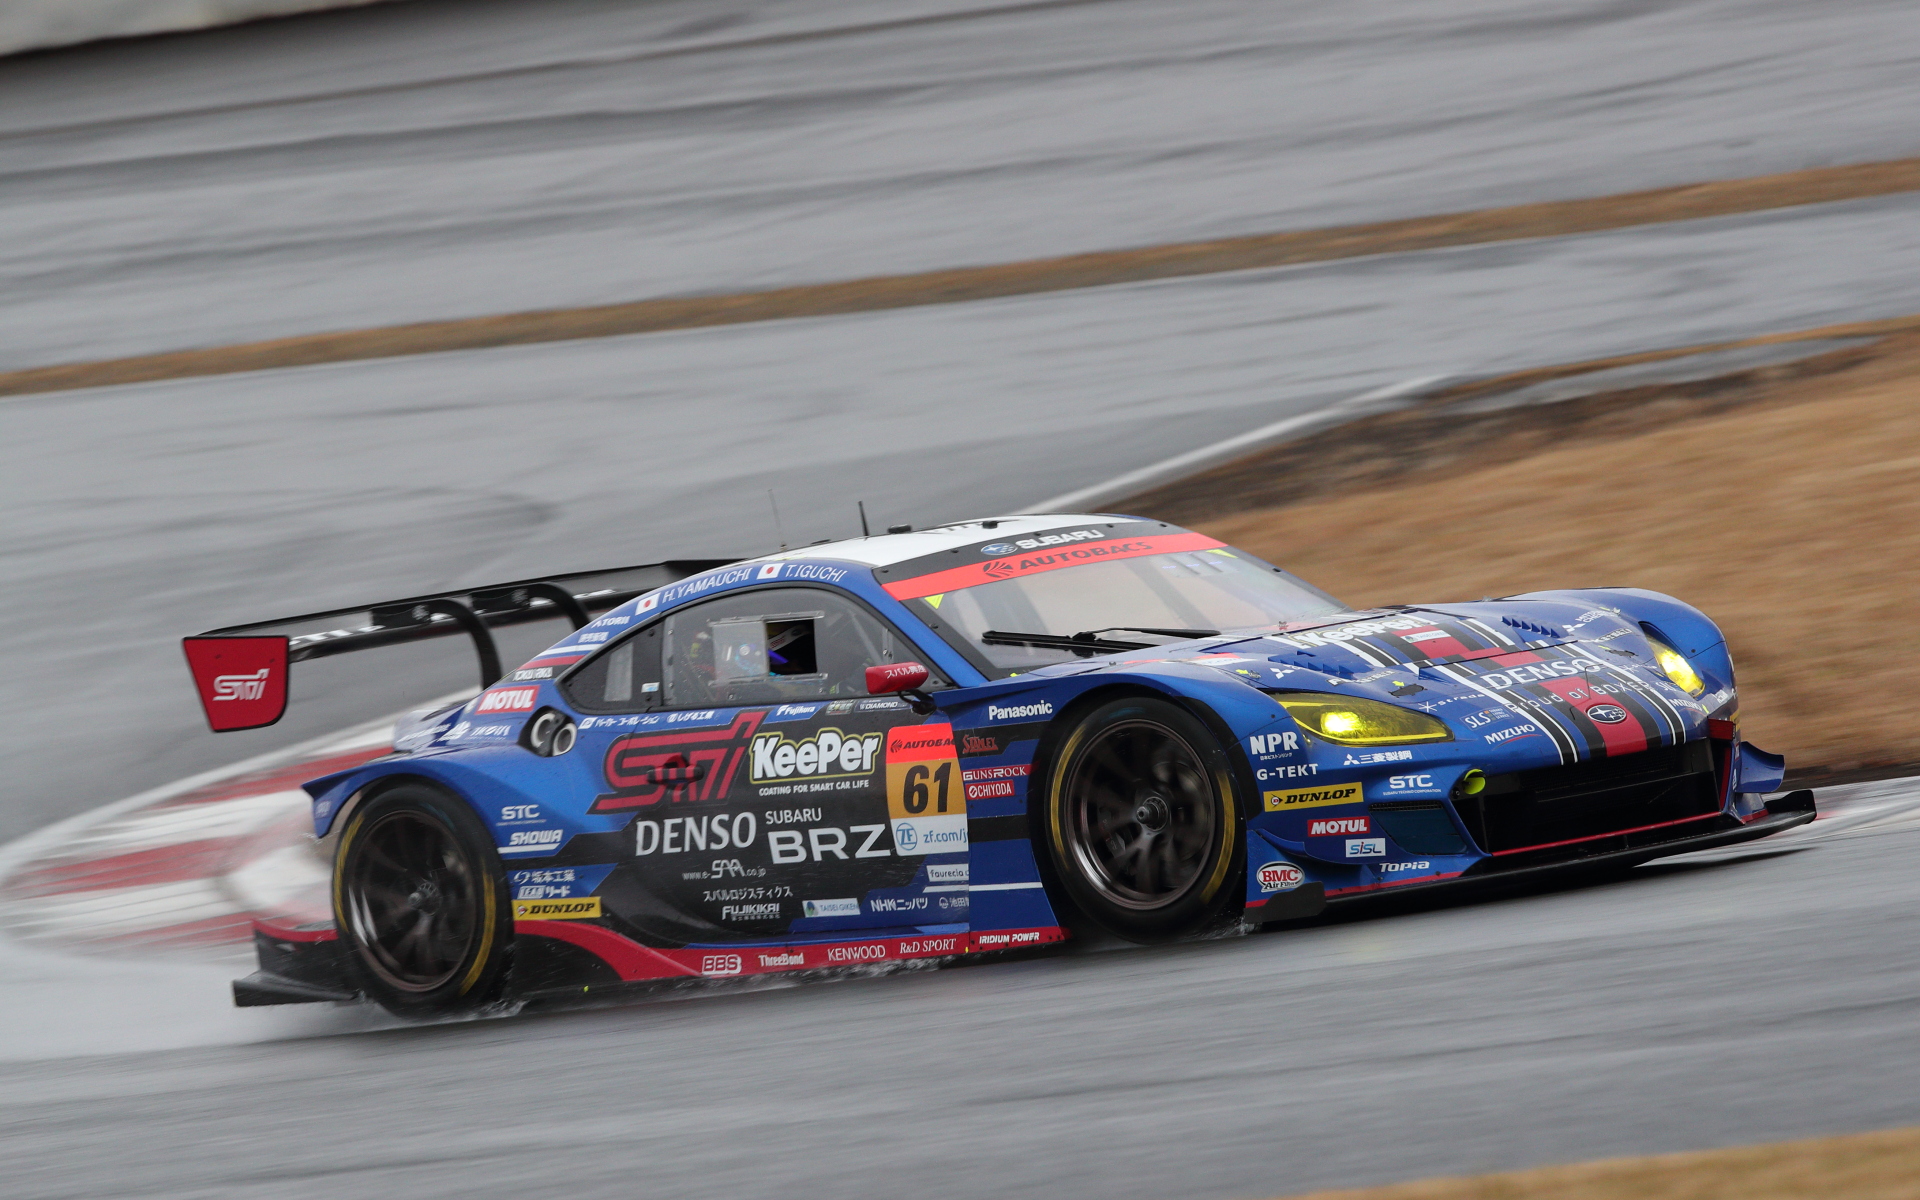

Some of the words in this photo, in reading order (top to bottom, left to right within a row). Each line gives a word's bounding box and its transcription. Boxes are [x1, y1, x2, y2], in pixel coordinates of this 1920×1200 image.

[1016, 529, 1105, 549] SUBARU
[1019, 541, 1153, 570] AUTOBACS
[785, 564, 848, 583] T.IGUCHI
[661, 567, 753, 603] H.YAMAUCHI
[1479, 658, 1600, 690] DENSO
[478, 689, 535, 712] MOTUL
[988, 700, 1053, 720] Panasonic
[1465, 711, 1491, 729] SLS
[1250, 731, 1300, 755] NPR
[1484, 724, 1536, 746] MIZUHO
[962, 734, 999, 755] STANLEY
[752, 732, 880, 780] KeePer
[1256, 763, 1319, 780] G-TEKT
[758, 785, 792, 797] COATING
[793, 783, 809, 793] FOR
[810, 782, 834, 793] SMART
[836, 780, 851, 790] CAR
[852, 779, 870, 789] LIFE
[902, 762, 952, 814] 61
[977, 782, 1013, 798] CHIYODA
[1389, 774, 1434, 789] STC
[1284, 788, 1357, 805] DUNLOP
[501, 804, 541, 821] STC
[764, 807, 822, 825] SUBARU
[635, 811, 757, 856] DENSO
[1311, 818, 1368, 835] MOTUL
[509, 829, 564, 846] SHOWA
[767, 823, 892, 865] BRZ
[923, 828, 968, 844] zf.com/j
[930, 869, 964, 878] faurecia
[1261, 869, 1299, 882] BMC
[702, 886, 794, 902] スバルロジスティクス
[1264, 881, 1279, 890] Air
[528, 902, 597, 915] DUNLOP
[722, 902, 780, 920] FUJIKIKAI
[899, 941, 920, 954] R&D
[922, 938, 956, 953] SPORT
[978, 934, 1010, 945] IRIDIUM
[1012, 931, 1040, 943] POWER
[758, 953, 804, 967] ThreeBond
[827, 944, 887, 962] KENWOOD
[703, 955, 741, 975] BBS
